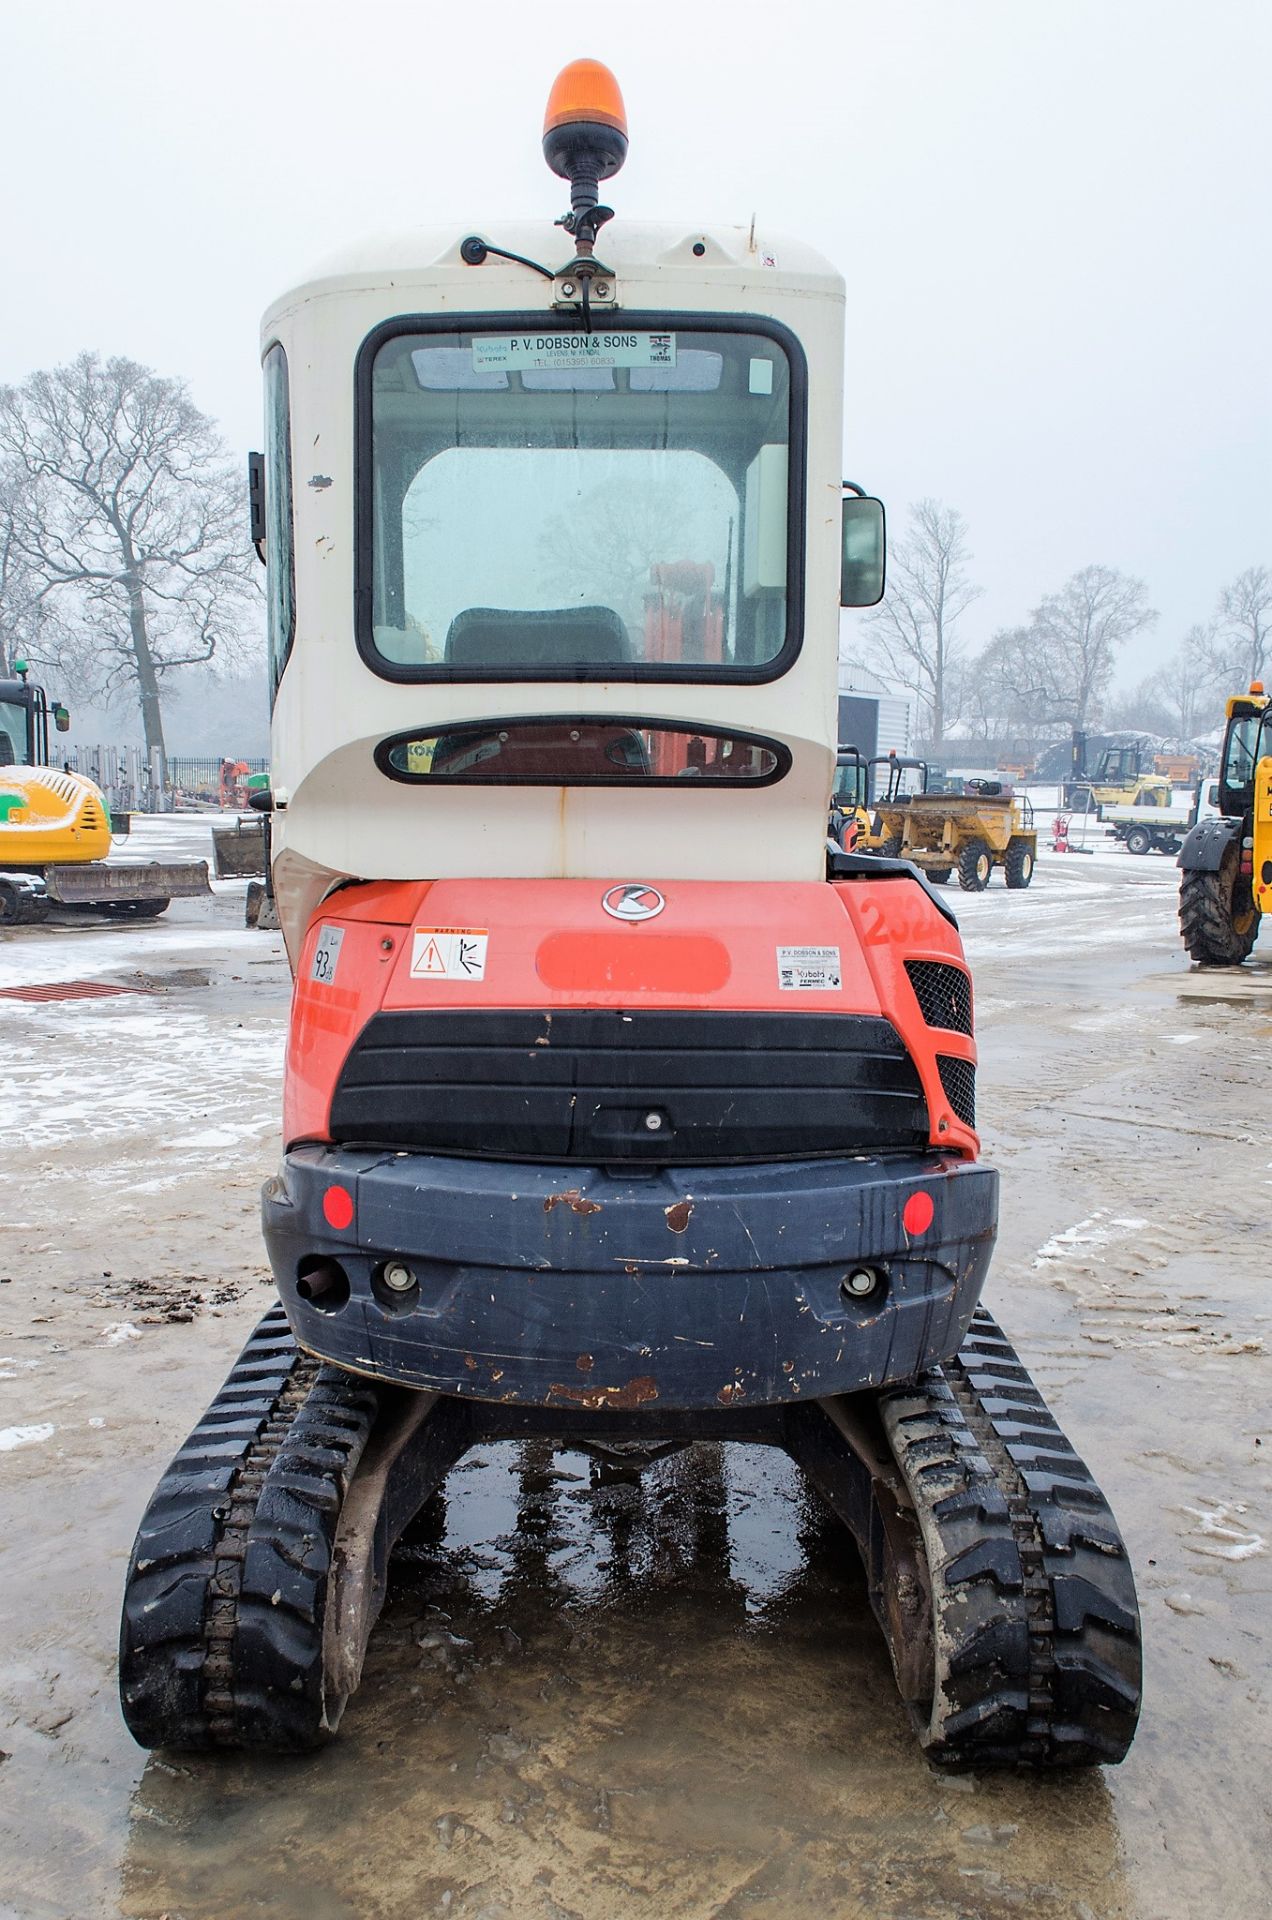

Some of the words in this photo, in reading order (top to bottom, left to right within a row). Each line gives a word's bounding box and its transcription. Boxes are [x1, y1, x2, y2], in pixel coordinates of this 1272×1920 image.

[510, 339, 520, 351] P.
[523, 338, 534, 351] V.
[536, 336, 589, 350] DOBSON
[592, 336, 601, 348] &
[603, 335, 638, 348] SONS
[316, 950, 330, 977] 93
